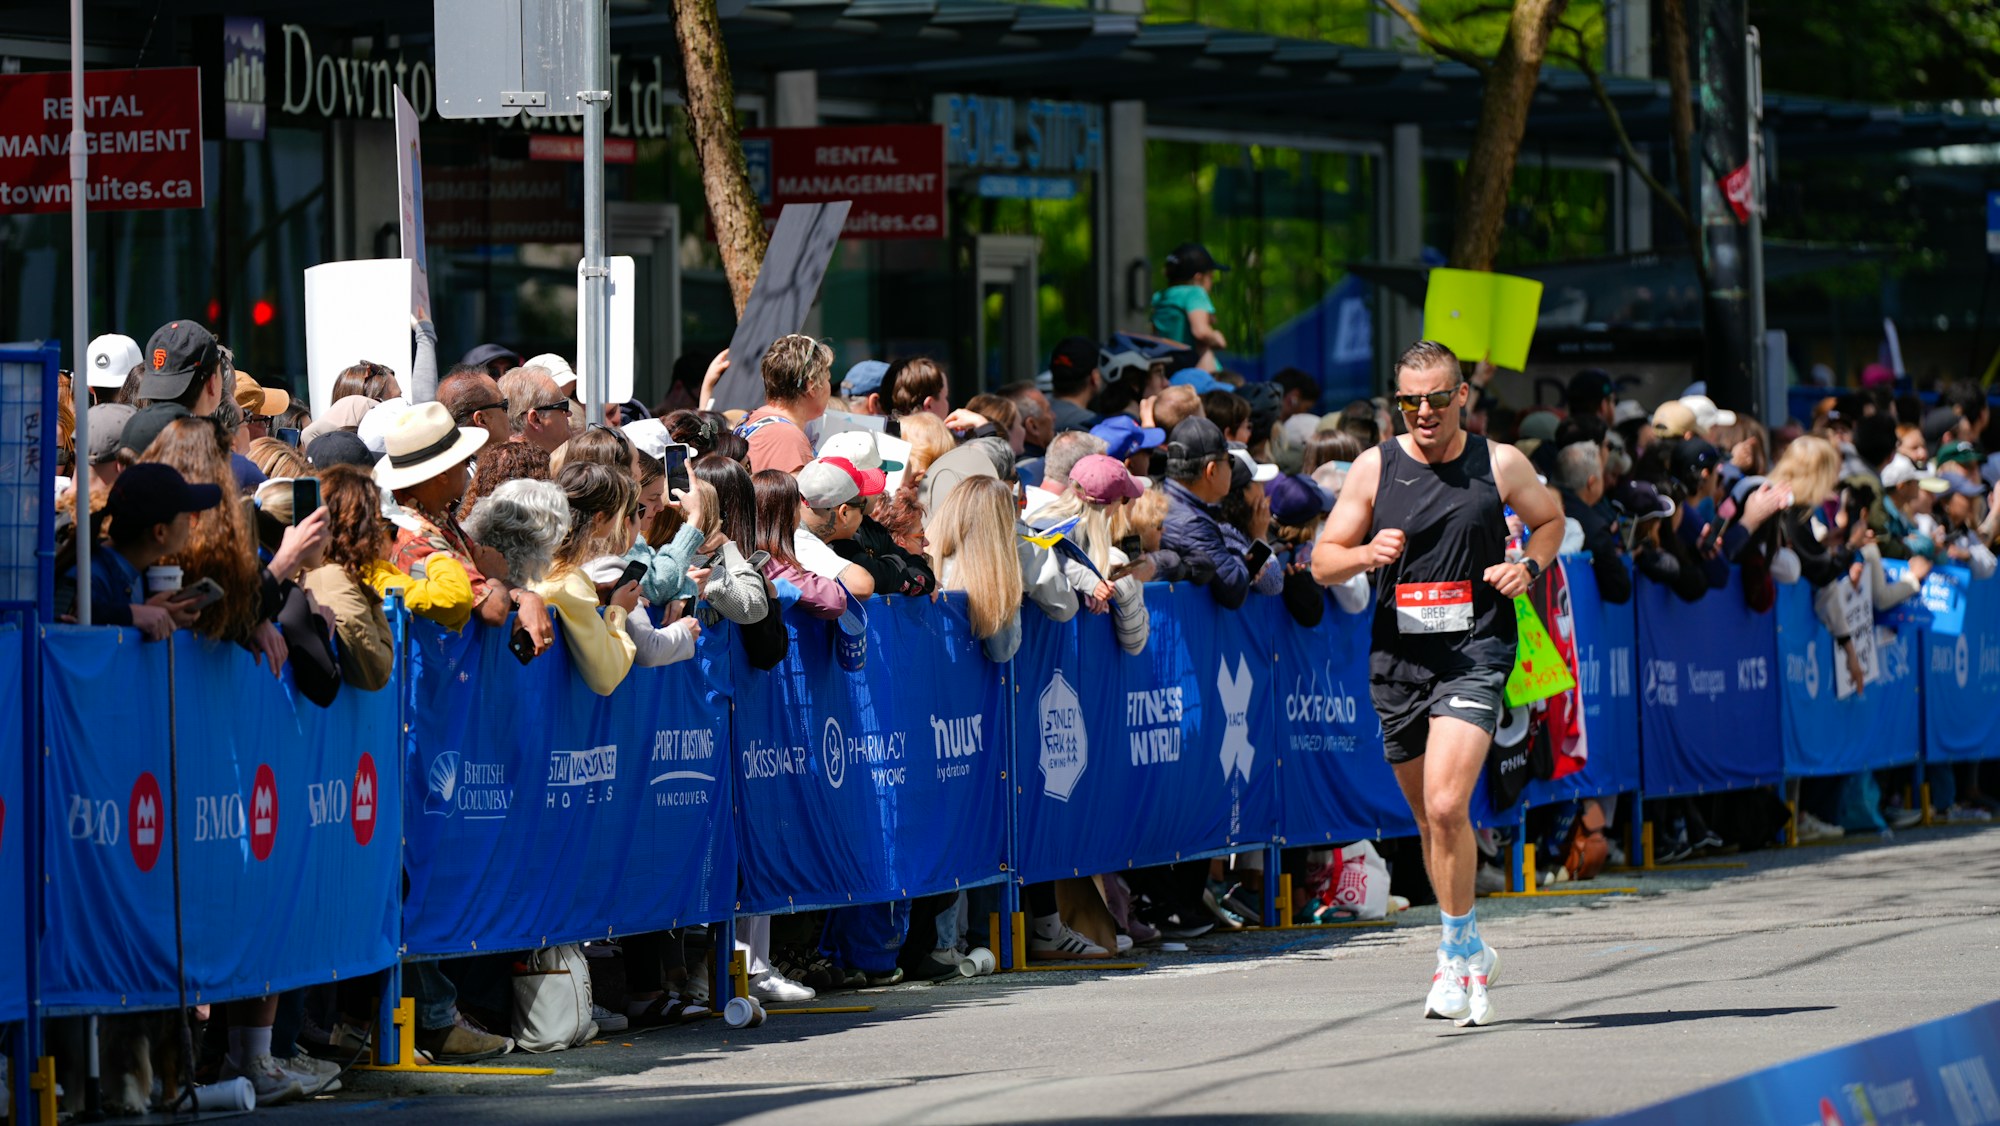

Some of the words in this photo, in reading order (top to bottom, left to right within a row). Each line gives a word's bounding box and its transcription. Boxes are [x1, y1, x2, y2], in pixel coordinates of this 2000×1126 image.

[815, 146, 899, 167] RENTAL
[0, 175, 192, 206] townuites.ca
[777, 173, 938, 196] MANAGEMENT
[1420, 606, 1446, 620] GREG
[1423, 620, 1446, 632] 2310
[1737, 656, 1768, 692] KITS
[1126, 686, 1183, 727] FITNESS
[1228, 711, 1245, 727] XACT
[681, 728, 714, 761] HOSTING
[847, 731, 906, 765] PHARMACY
[1130, 727, 1181, 767] WORLD
[464, 760, 505, 785] BRITISH
[548, 755, 570, 781] STAY
[936, 761, 970, 783] hydration
[656, 790, 709, 807] VANCOUVER
[194, 793, 242, 842] BMO
